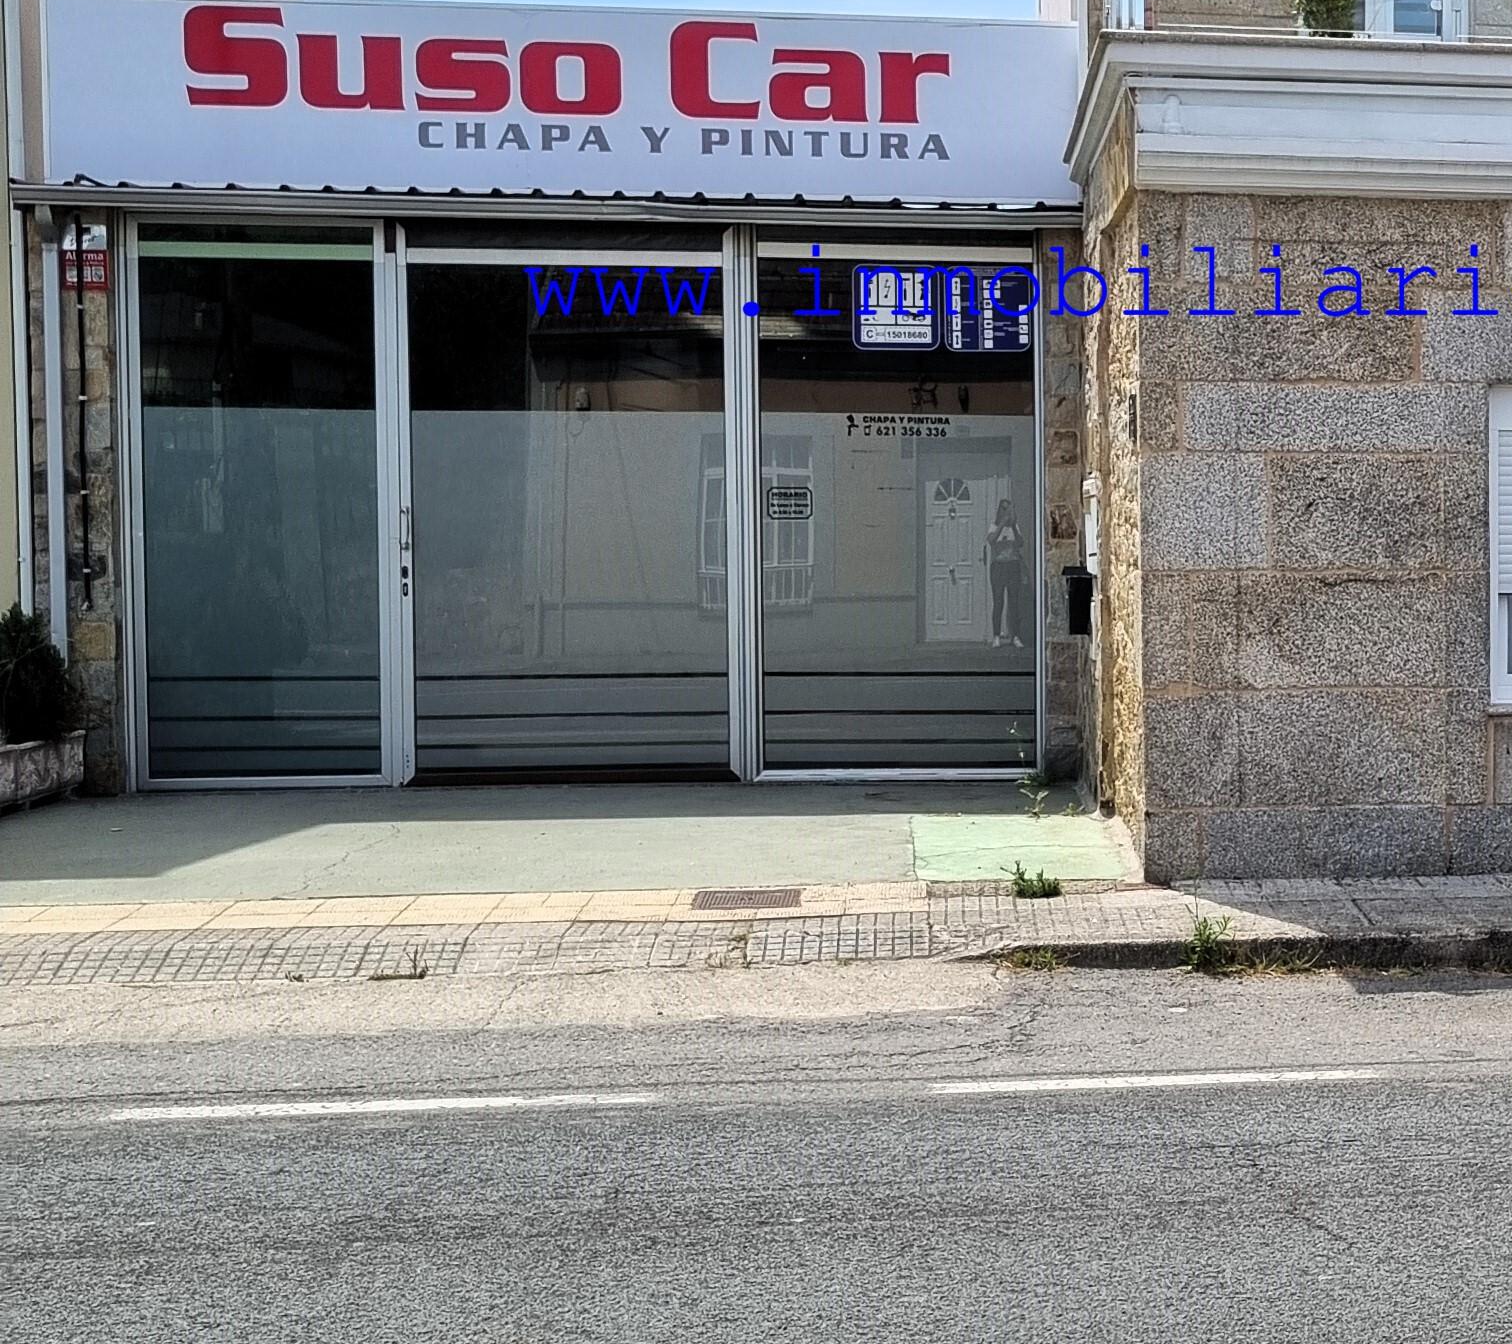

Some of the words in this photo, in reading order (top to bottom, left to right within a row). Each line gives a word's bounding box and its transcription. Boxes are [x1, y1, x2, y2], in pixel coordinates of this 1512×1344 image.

[183, 5, 622, 116] Suso
[670, 21, 951, 124] Car
[417, 121, 612, 152] CHAPA
[640, 126, 671, 154] Y
[700, 127, 951, 160] PINTURA
[65, 251, 104, 260] Alrma
[862, 415, 897, 424] CHAPA
[898, 416, 906, 425] Y
[907, 416, 951, 426] PINTURA
[876, 426, 896, 437] 621
[901, 426, 922, 437] 356
[926, 427, 947, 438] 336
